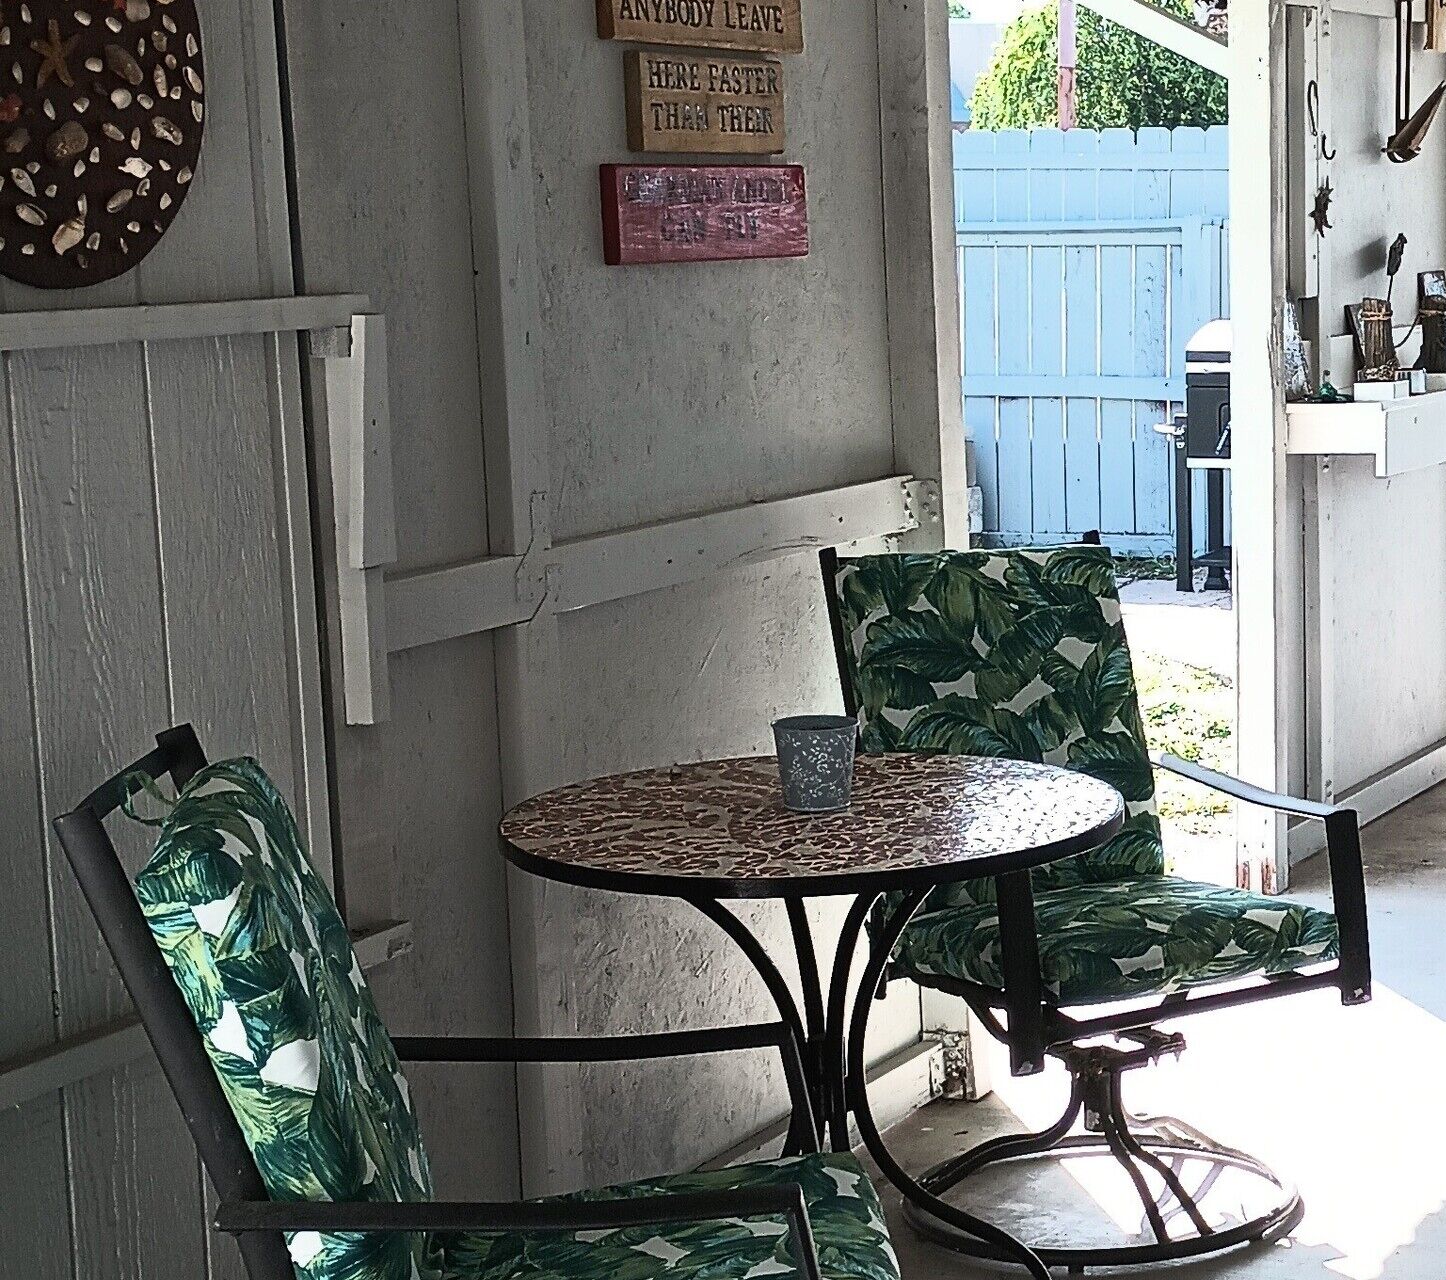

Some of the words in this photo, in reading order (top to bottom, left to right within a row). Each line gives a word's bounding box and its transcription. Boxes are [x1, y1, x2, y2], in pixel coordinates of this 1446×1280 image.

[724, 0, 784, 34] LEAVE
[648, 60, 700, 91] HERE
[708, 61, 779, 94] FASTER
[650, 103, 708, 131] THAN
[717, 104, 774, 134] THEIR
